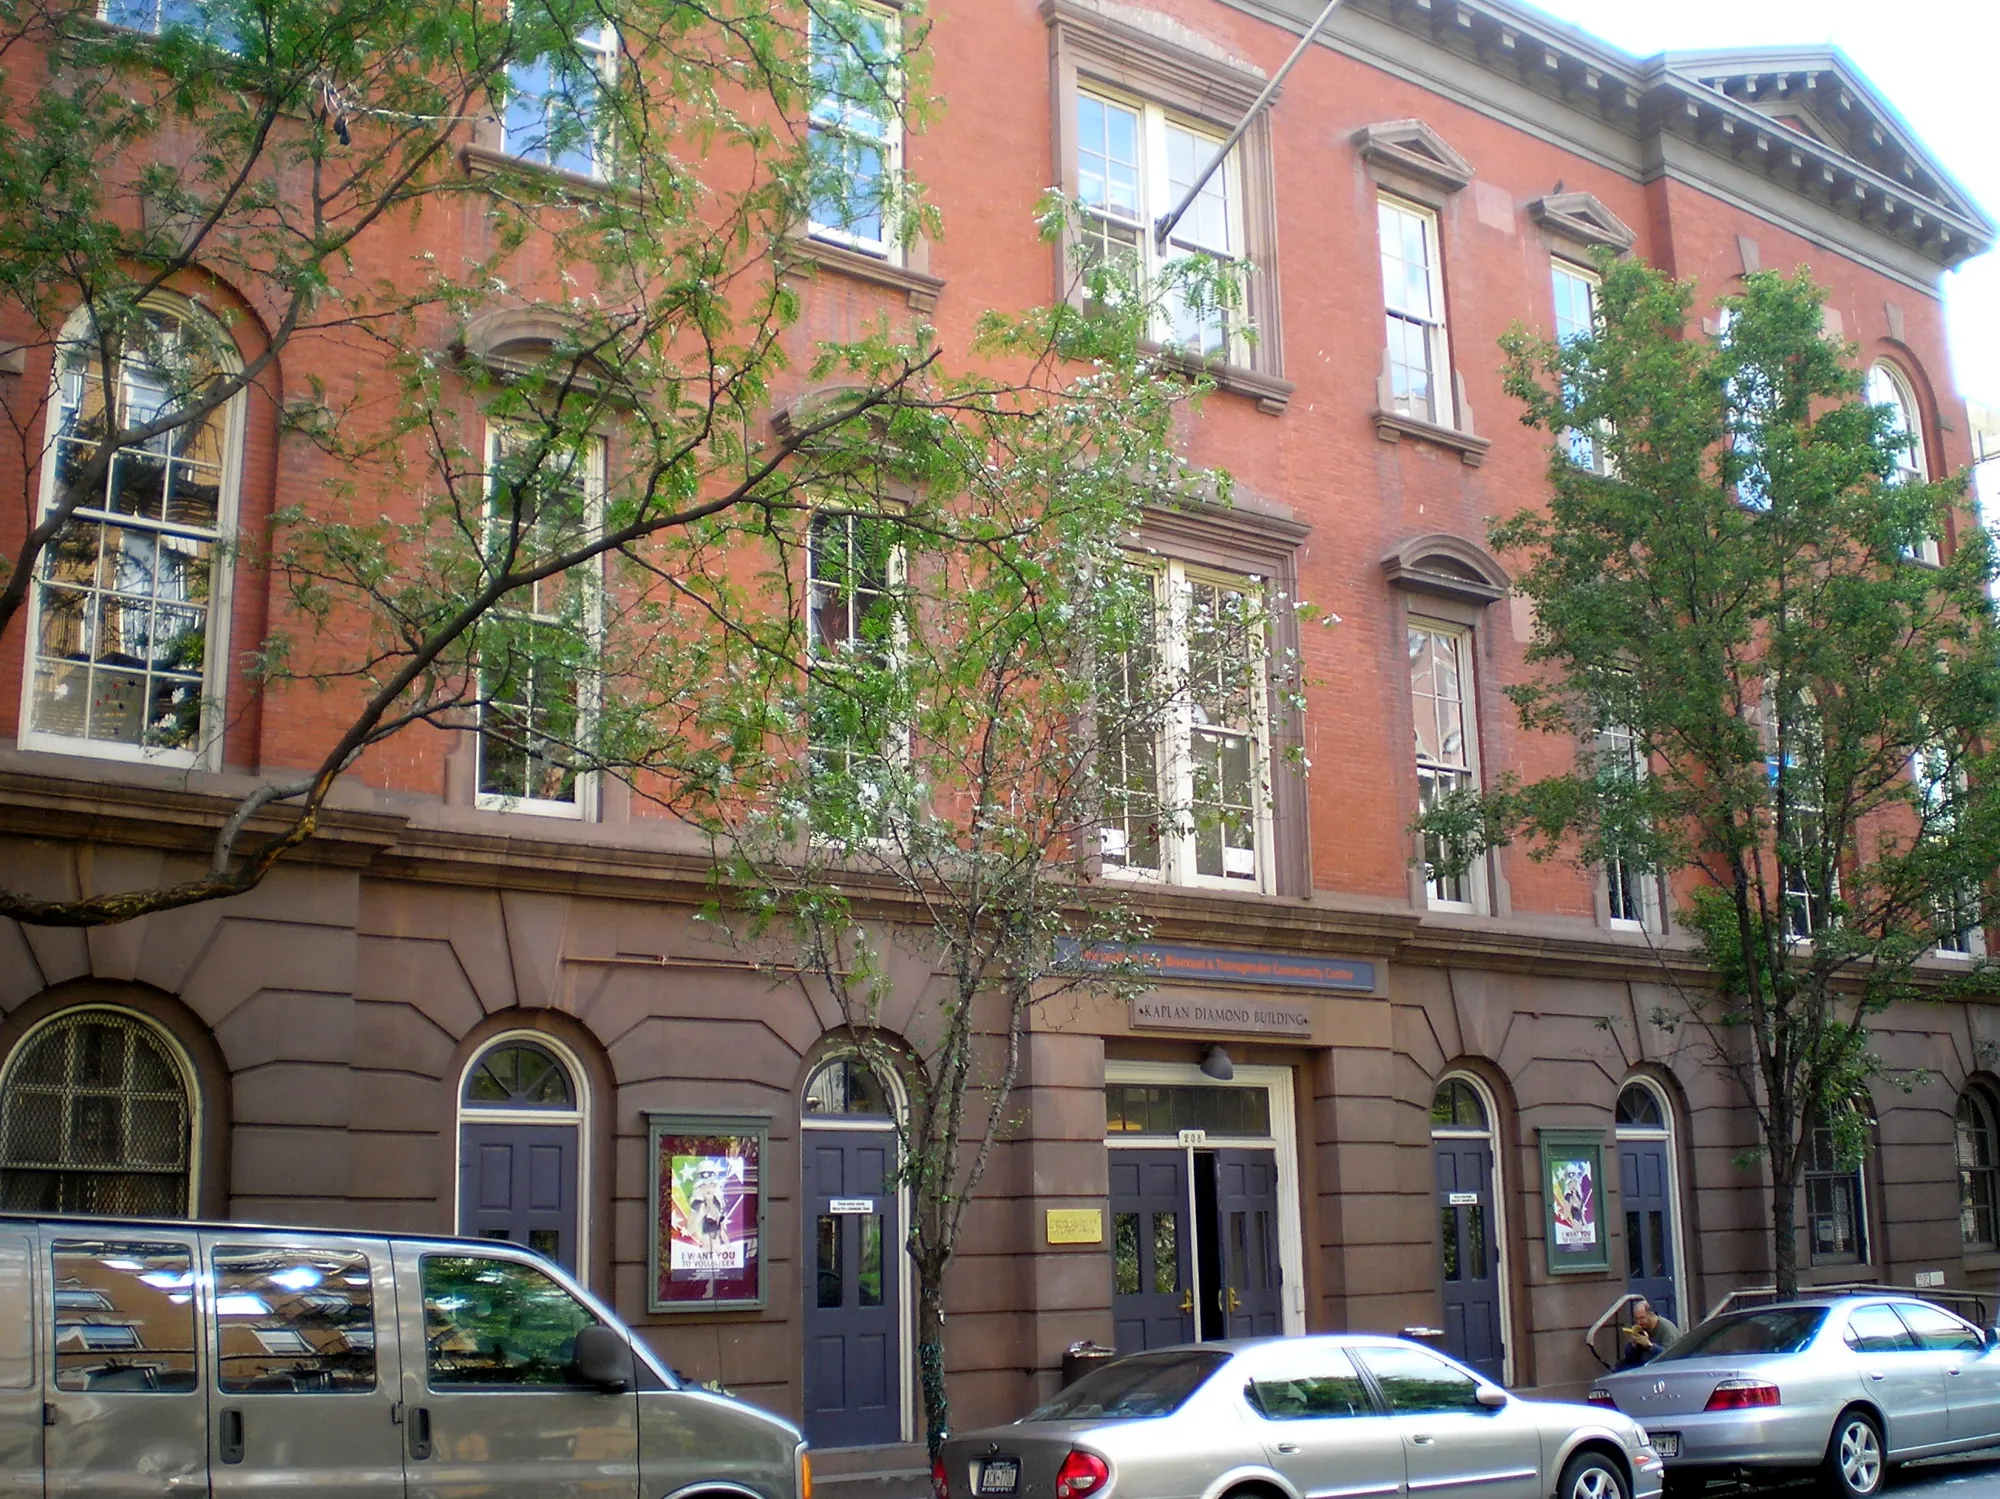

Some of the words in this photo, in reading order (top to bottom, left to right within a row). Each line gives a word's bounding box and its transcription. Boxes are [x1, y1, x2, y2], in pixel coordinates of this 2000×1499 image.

[1144, 1004, 1190, 1019] KAPLAN
[1195, 1007, 1249, 1023] DIAMOND
[1254, 1011, 1304, 1026] BUILDING
[687, 1252, 713, 1260] WANT
[716, 1251, 736, 1260] YOU
